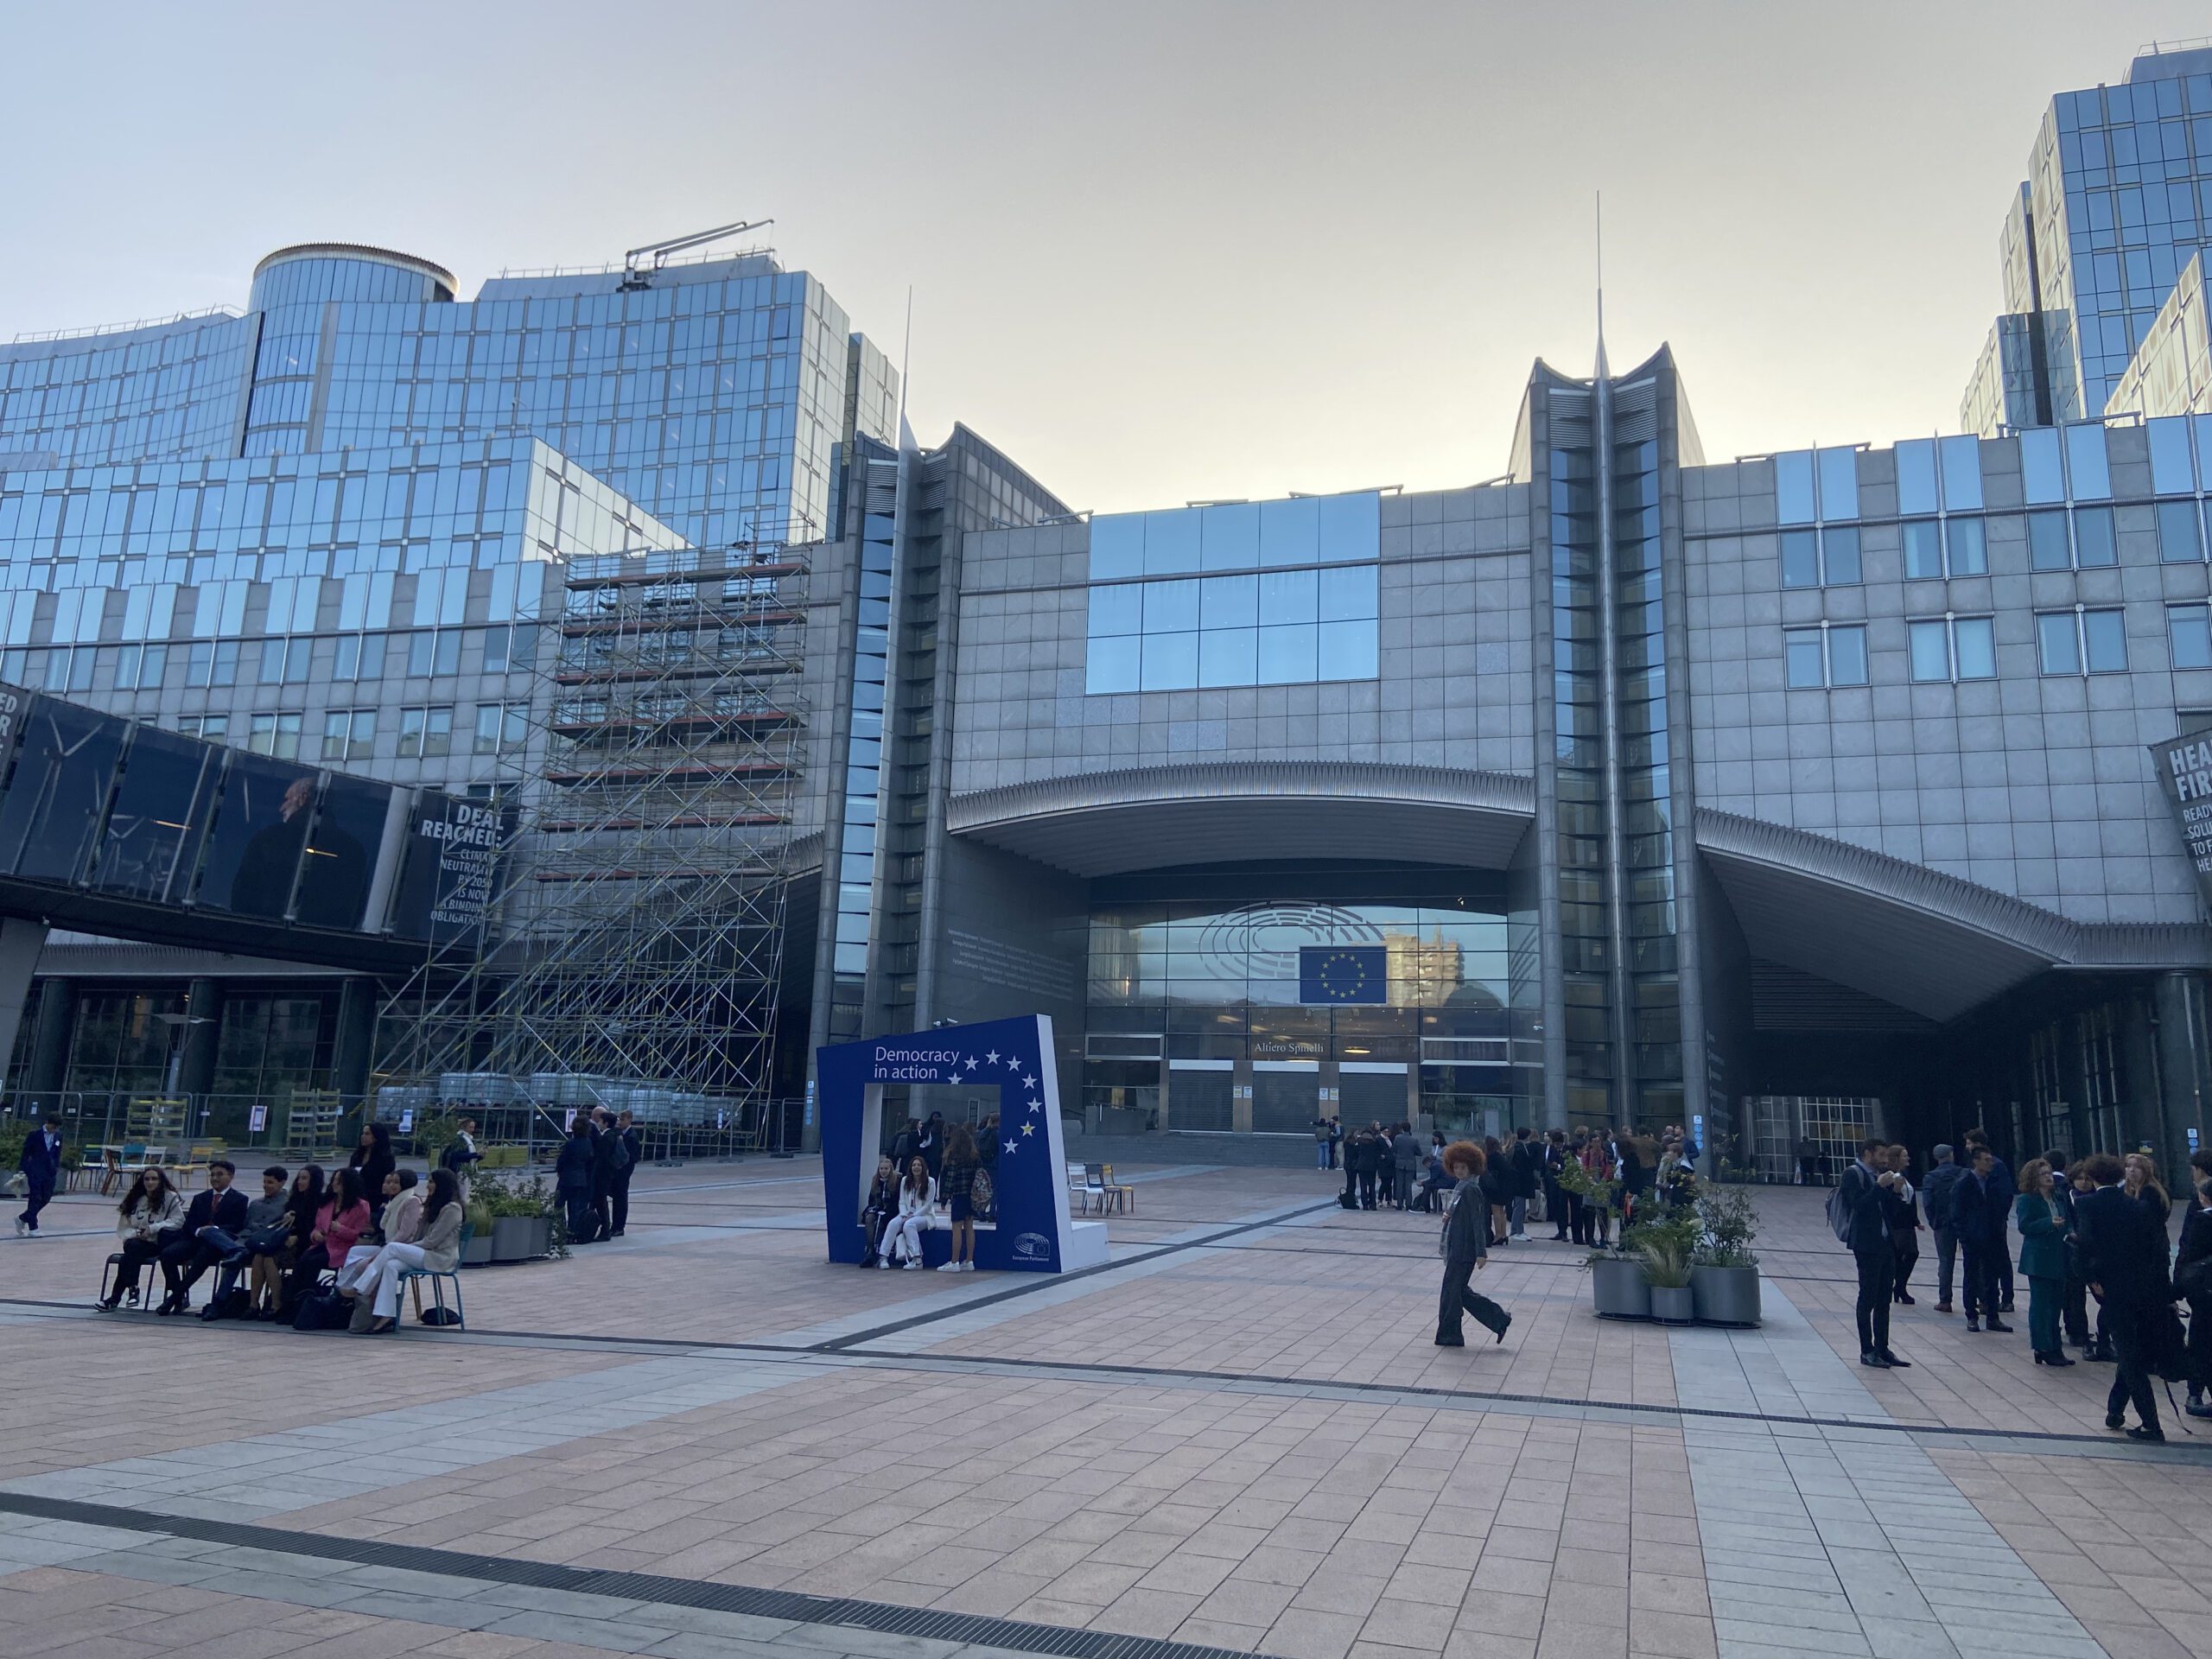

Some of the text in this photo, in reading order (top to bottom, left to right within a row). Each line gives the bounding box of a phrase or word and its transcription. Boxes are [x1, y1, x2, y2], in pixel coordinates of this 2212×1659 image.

[2169, 739, 2212, 775] HEA
[2176, 769, 2212, 802] FIR
[457, 804, 504, 830] DEAL
[421, 819, 502, 848] REACHED:
[2191, 841, 2206, 856] TO
[457, 874, 493, 888] BY 2050
[457, 887, 467, 898] IS
[448, 899, 486, 912] BINDIN
[1255, 1041, 1324, 1054] Altiero Spinelli
[875, 1046, 960, 1065] Democracy
[874, 1064, 938, 1078] in action
